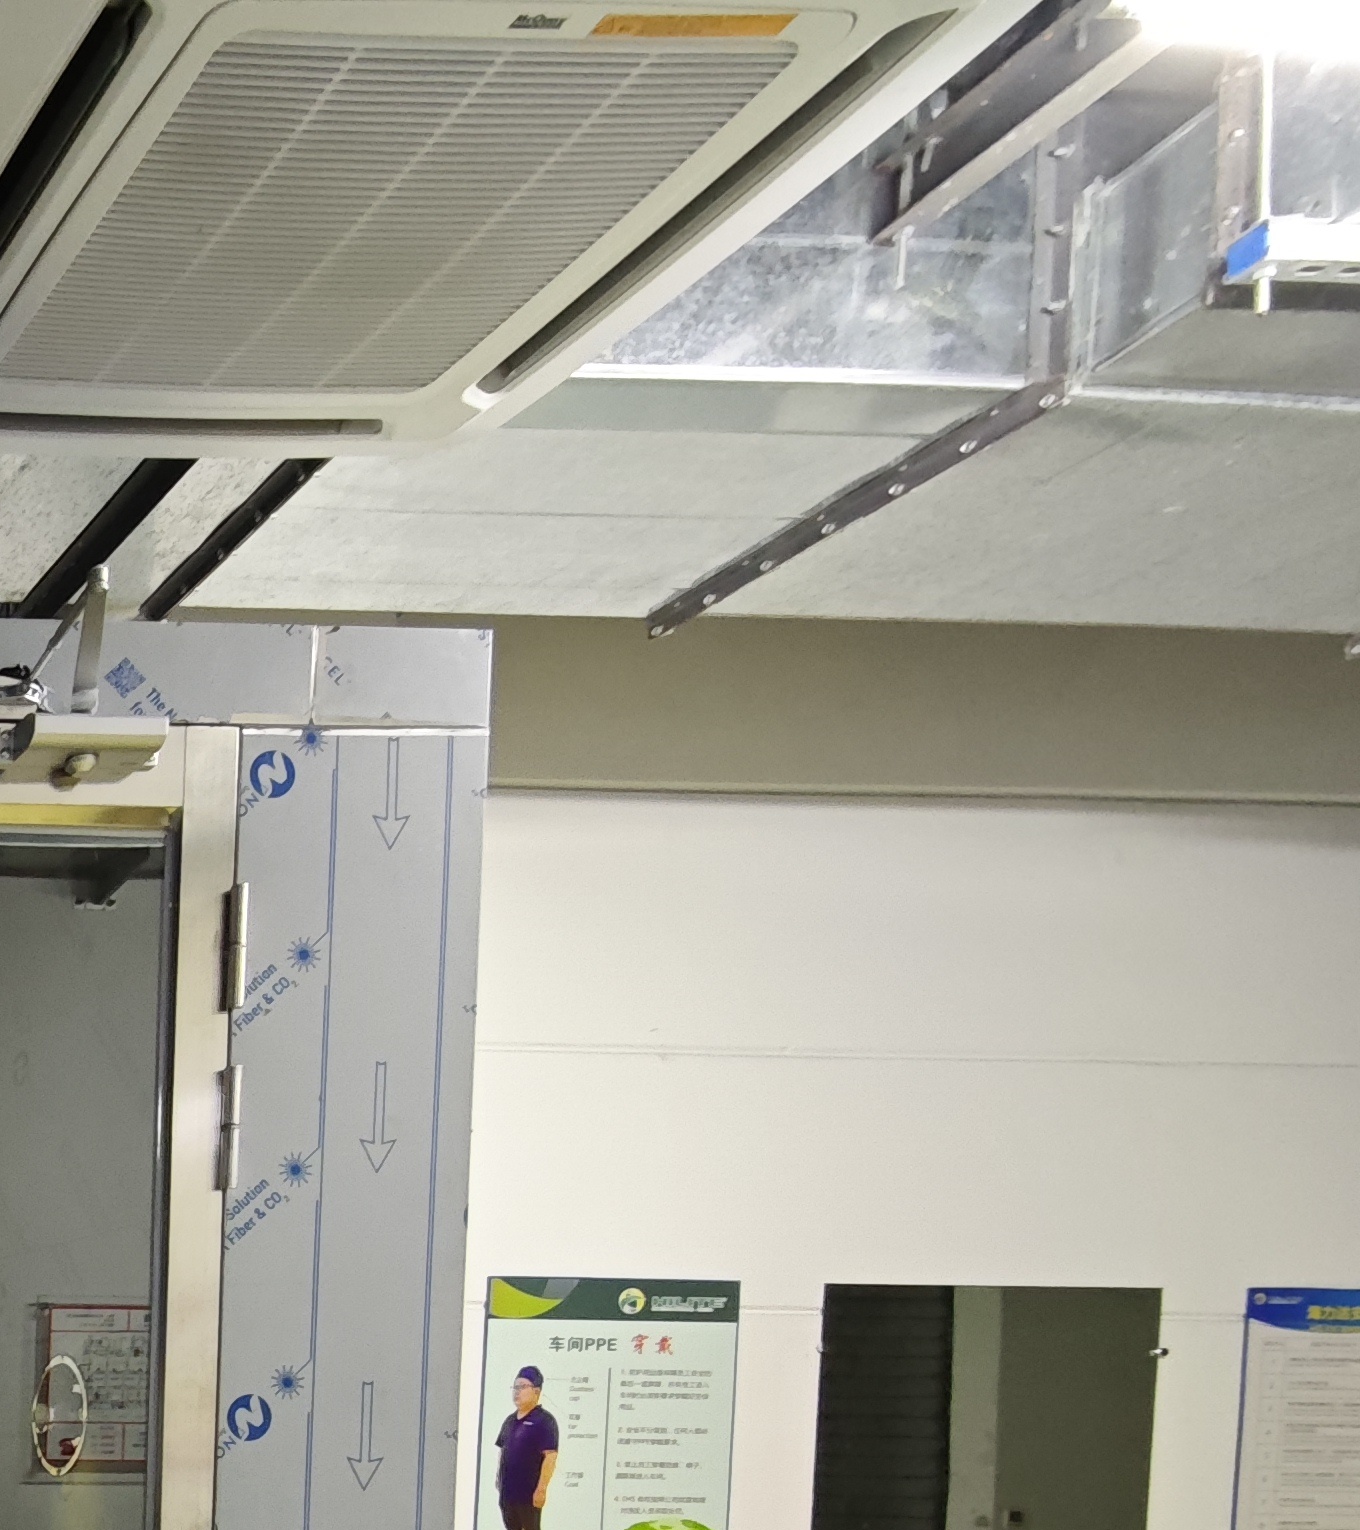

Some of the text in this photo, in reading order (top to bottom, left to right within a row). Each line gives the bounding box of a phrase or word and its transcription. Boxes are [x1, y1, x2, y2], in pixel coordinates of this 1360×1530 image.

[230, 1001, 264, 1031] Fiber
[223, 1216, 256, 1246] Fiber
[548, 1335, 618, 1353] 车间PPE
